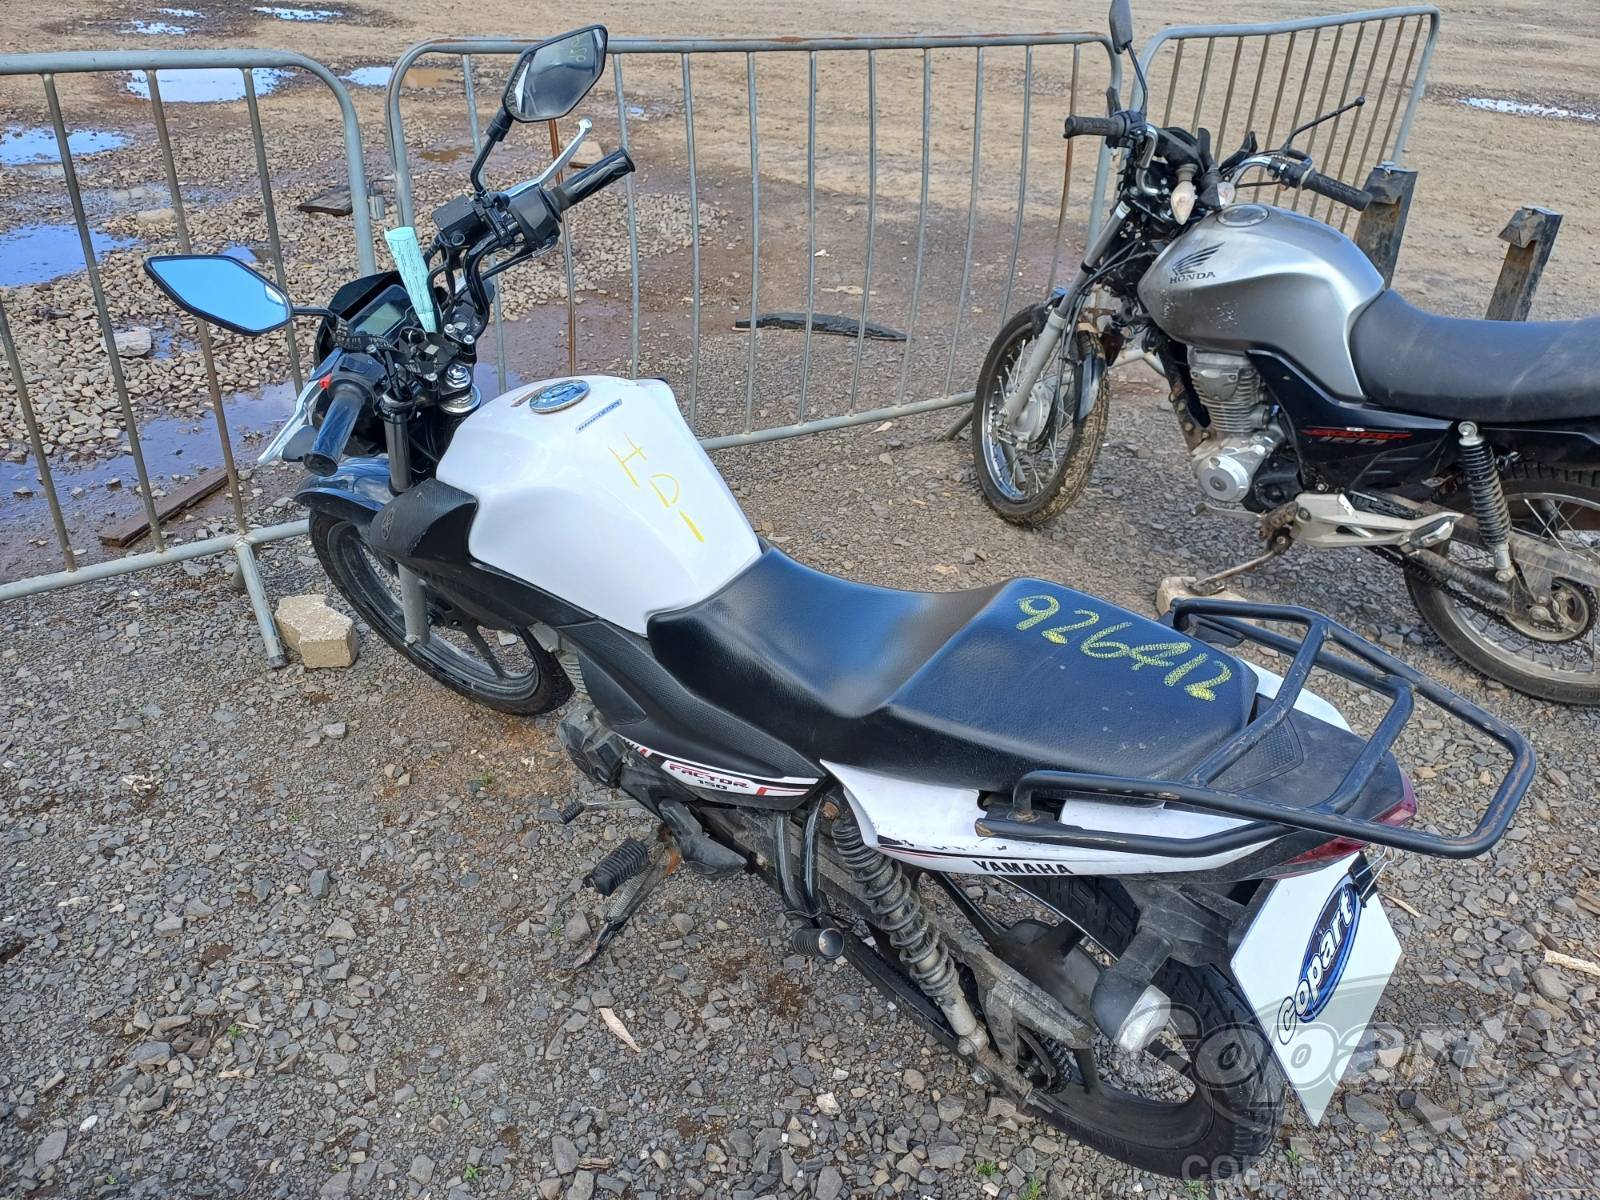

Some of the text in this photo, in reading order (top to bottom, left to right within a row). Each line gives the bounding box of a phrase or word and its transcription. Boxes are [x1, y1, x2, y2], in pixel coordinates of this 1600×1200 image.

[1169, 271, 1216, 284] HONDA
[1015, 594, 1233, 702] 926412
[669, 763, 749, 789] FACTOR
[696, 779, 728, 791] 150
[972, 860, 1075, 875] YAMAHA
[1276, 883, 1356, 1046] Copart
